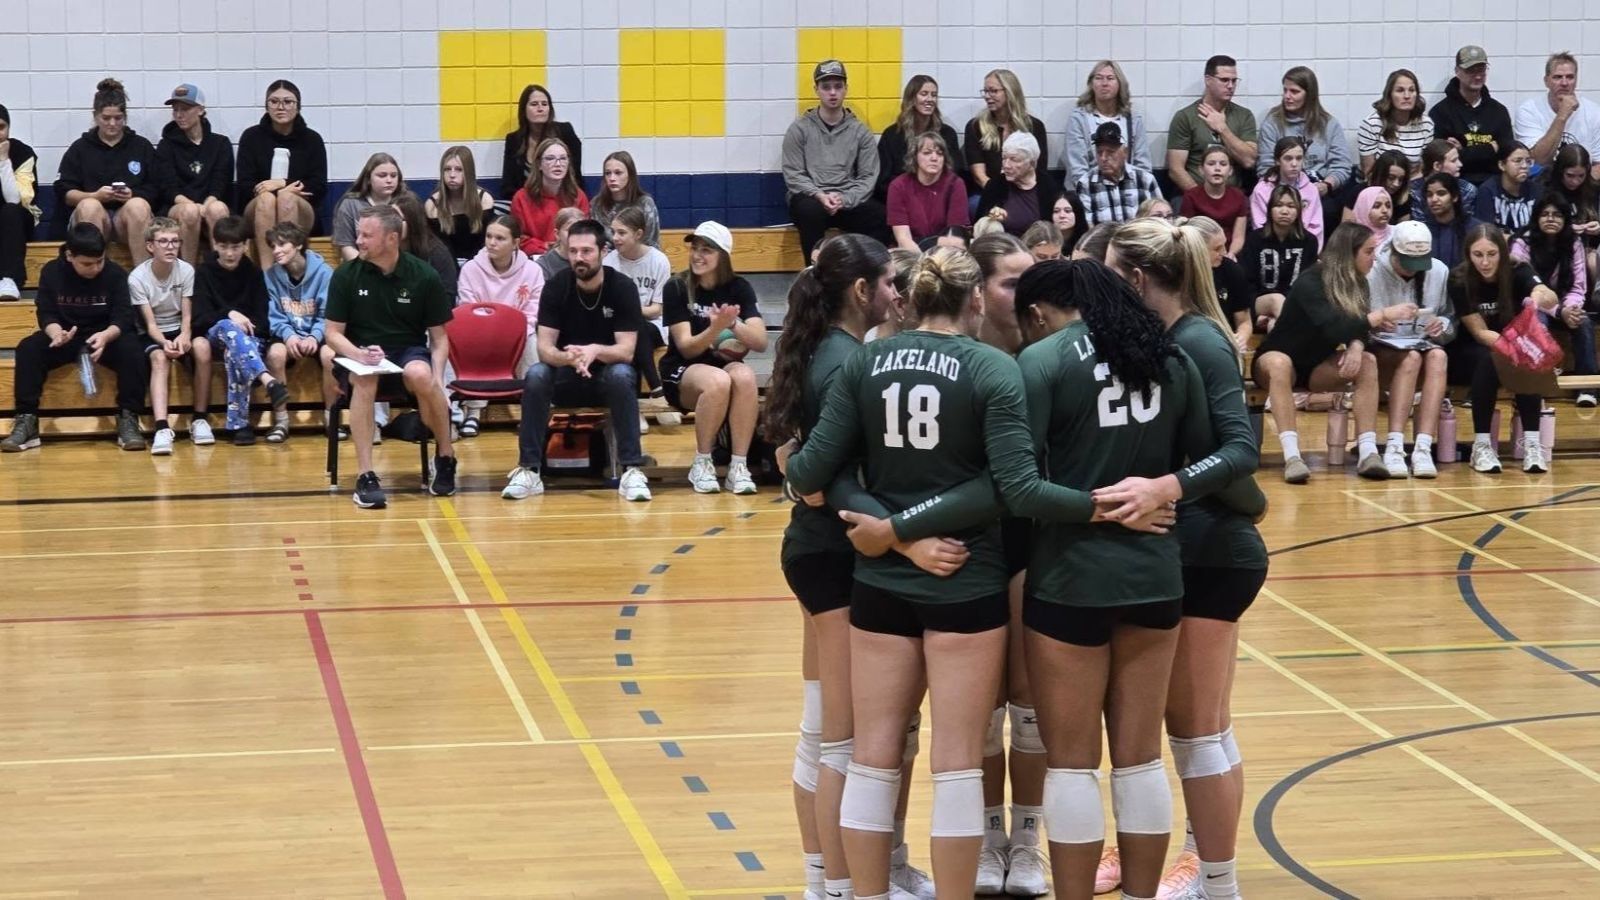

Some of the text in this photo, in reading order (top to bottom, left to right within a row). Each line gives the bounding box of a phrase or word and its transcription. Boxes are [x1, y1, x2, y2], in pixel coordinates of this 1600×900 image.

[1260, 248, 1304, 288] 87
[871, 349, 960, 381] LAKELAND
[882, 382, 941, 449] 18
[1184, 455, 1221, 477] TRUST
[902, 495, 942, 520] TRUST
